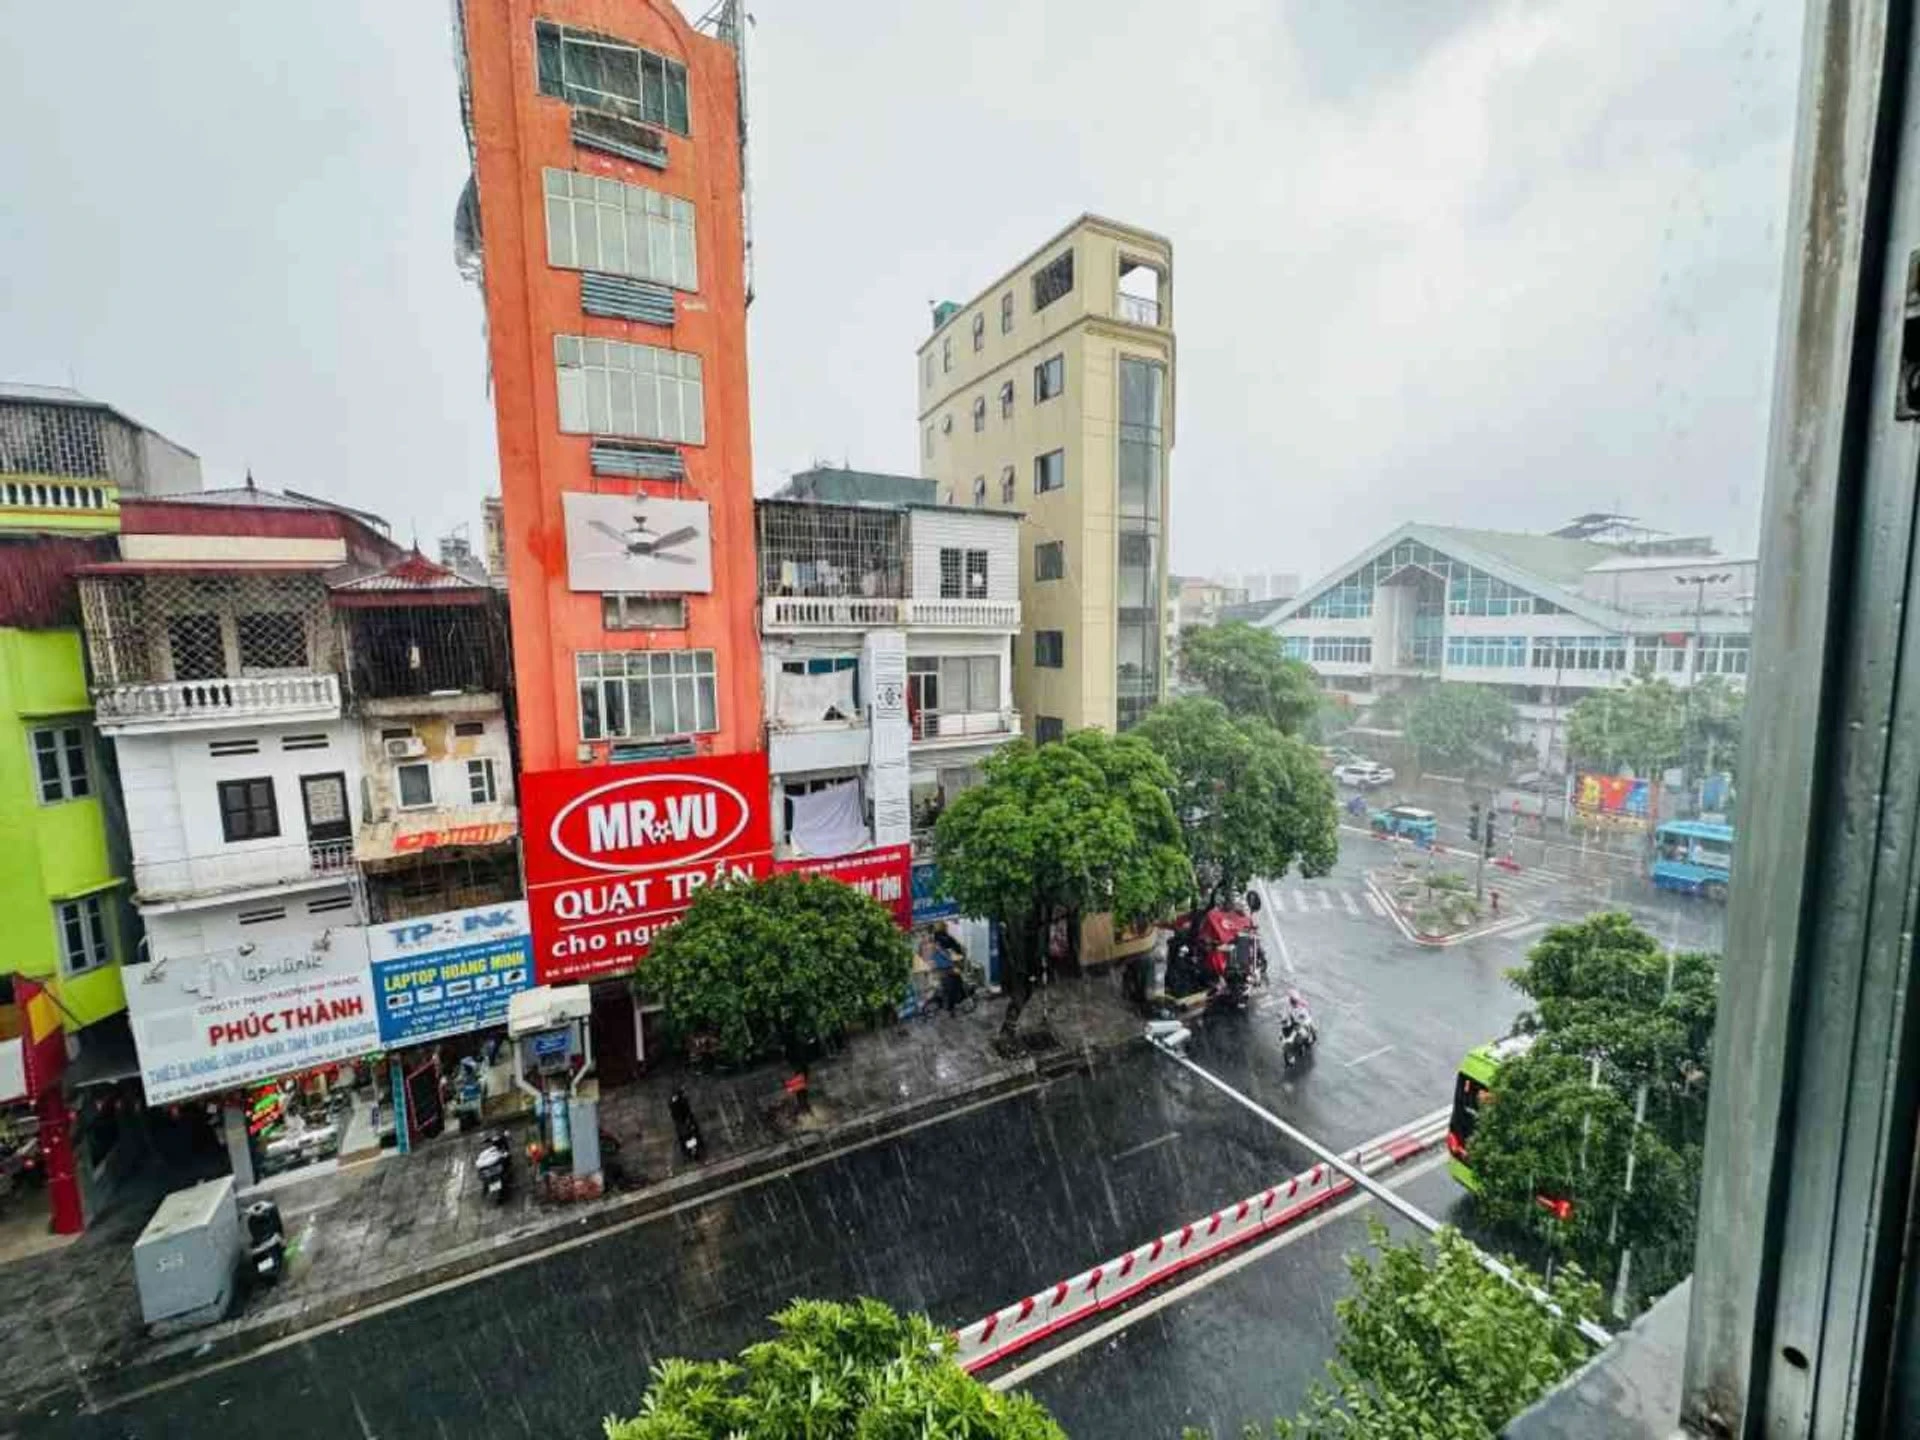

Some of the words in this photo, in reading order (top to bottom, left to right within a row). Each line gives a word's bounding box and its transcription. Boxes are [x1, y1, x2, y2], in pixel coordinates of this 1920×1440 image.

[588, 798, 655, 853] MR
[671, 792, 718, 842] VU
[553, 879, 653, 920] QUẠT
[552, 933, 606, 958] cho
[384, 967, 438, 993] LAPTOP
[208, 1012, 279, 1047] PHÚC
[279, 995, 364, 1030] THÀNH
